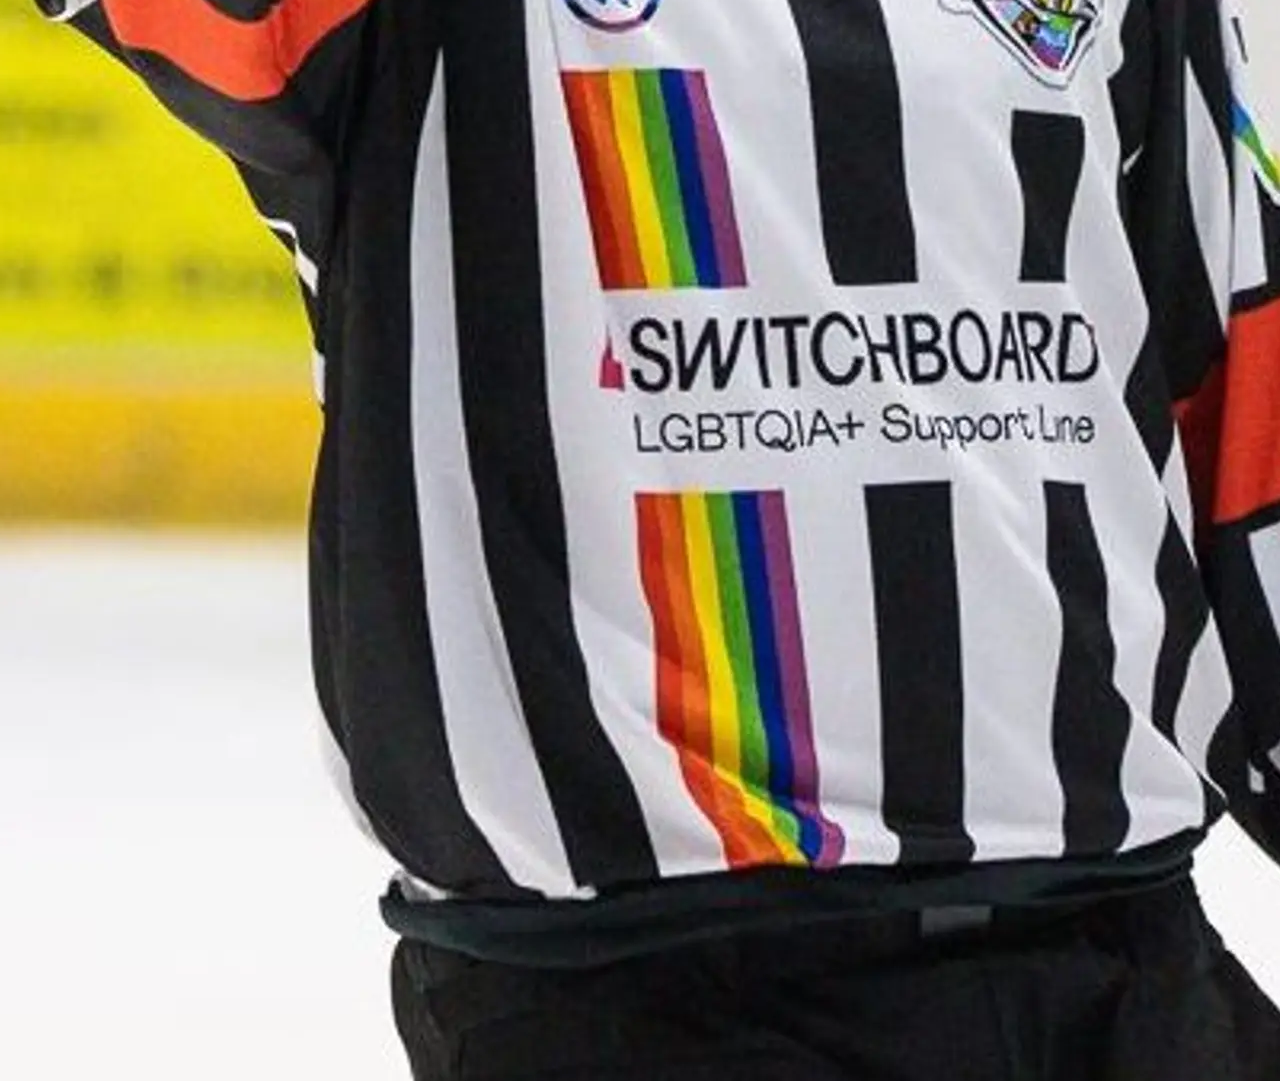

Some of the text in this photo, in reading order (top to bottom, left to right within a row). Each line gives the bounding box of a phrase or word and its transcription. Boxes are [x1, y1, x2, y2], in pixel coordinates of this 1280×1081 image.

[629, 309, 1100, 393] SWITCHBOARD
[633, 402, 1096, 452] LGBTQIA+ Support Lne
